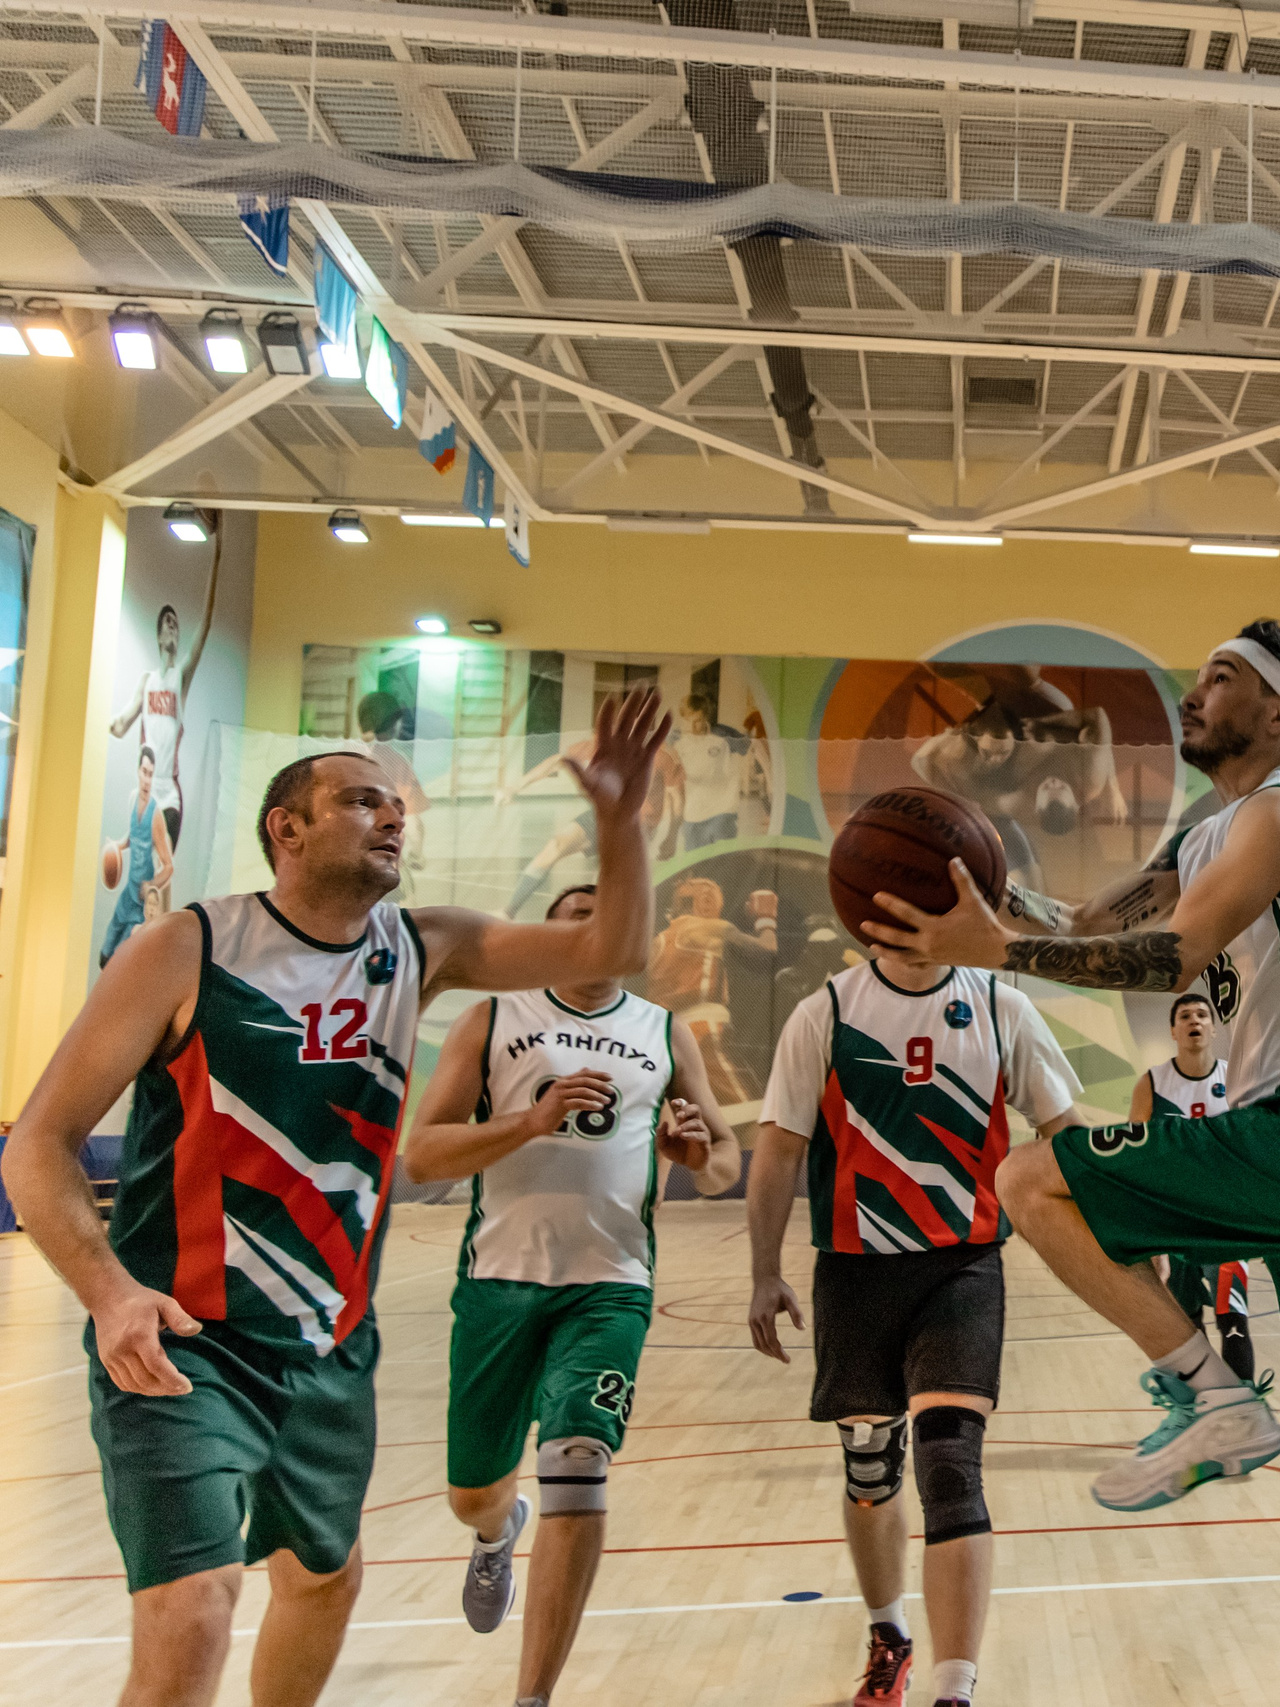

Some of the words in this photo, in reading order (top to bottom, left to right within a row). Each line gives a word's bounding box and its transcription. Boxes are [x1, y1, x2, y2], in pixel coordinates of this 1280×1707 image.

[299, 998, 368, 1062] 12
[507, 1032, 547, 1060] НК
[556, 1032, 657, 1072] ЯНГПУР
[904, 1036, 933, 1085] 9
[530, 1074, 623, 1141] 8
